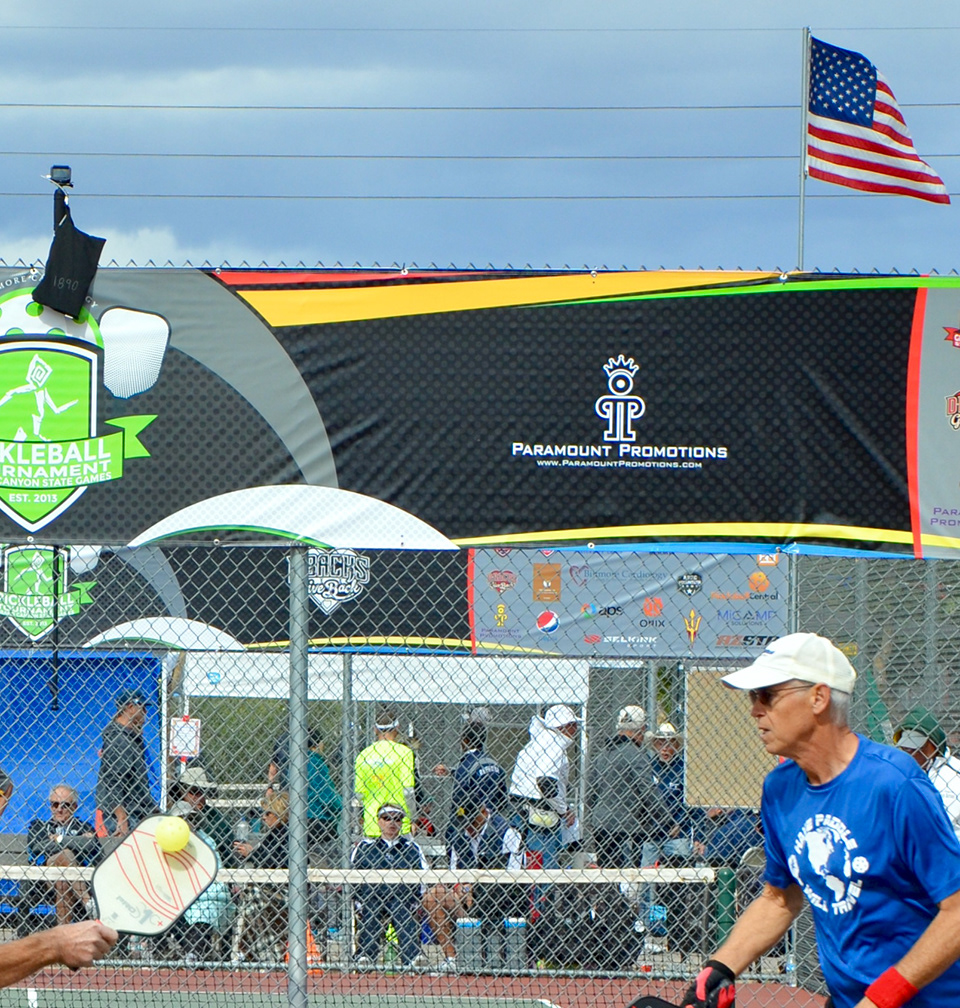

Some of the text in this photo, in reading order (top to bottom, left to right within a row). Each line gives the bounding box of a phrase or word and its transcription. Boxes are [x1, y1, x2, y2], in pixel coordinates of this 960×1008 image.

[53, 275, 79, 291] 1890
[512, 442, 728, 458] PARAMOUNT PROMOTIONS
[42, 476, 72, 487] STATE
[76, 472, 112, 484] GAMES
[8, 494, 58, 503] EST. 2013
[308, 554, 369, 582] BACKS
[322, 580, 360, 600] Back
[598, 606, 623, 618] aps
[815, 814, 858, 850] PADDLE
